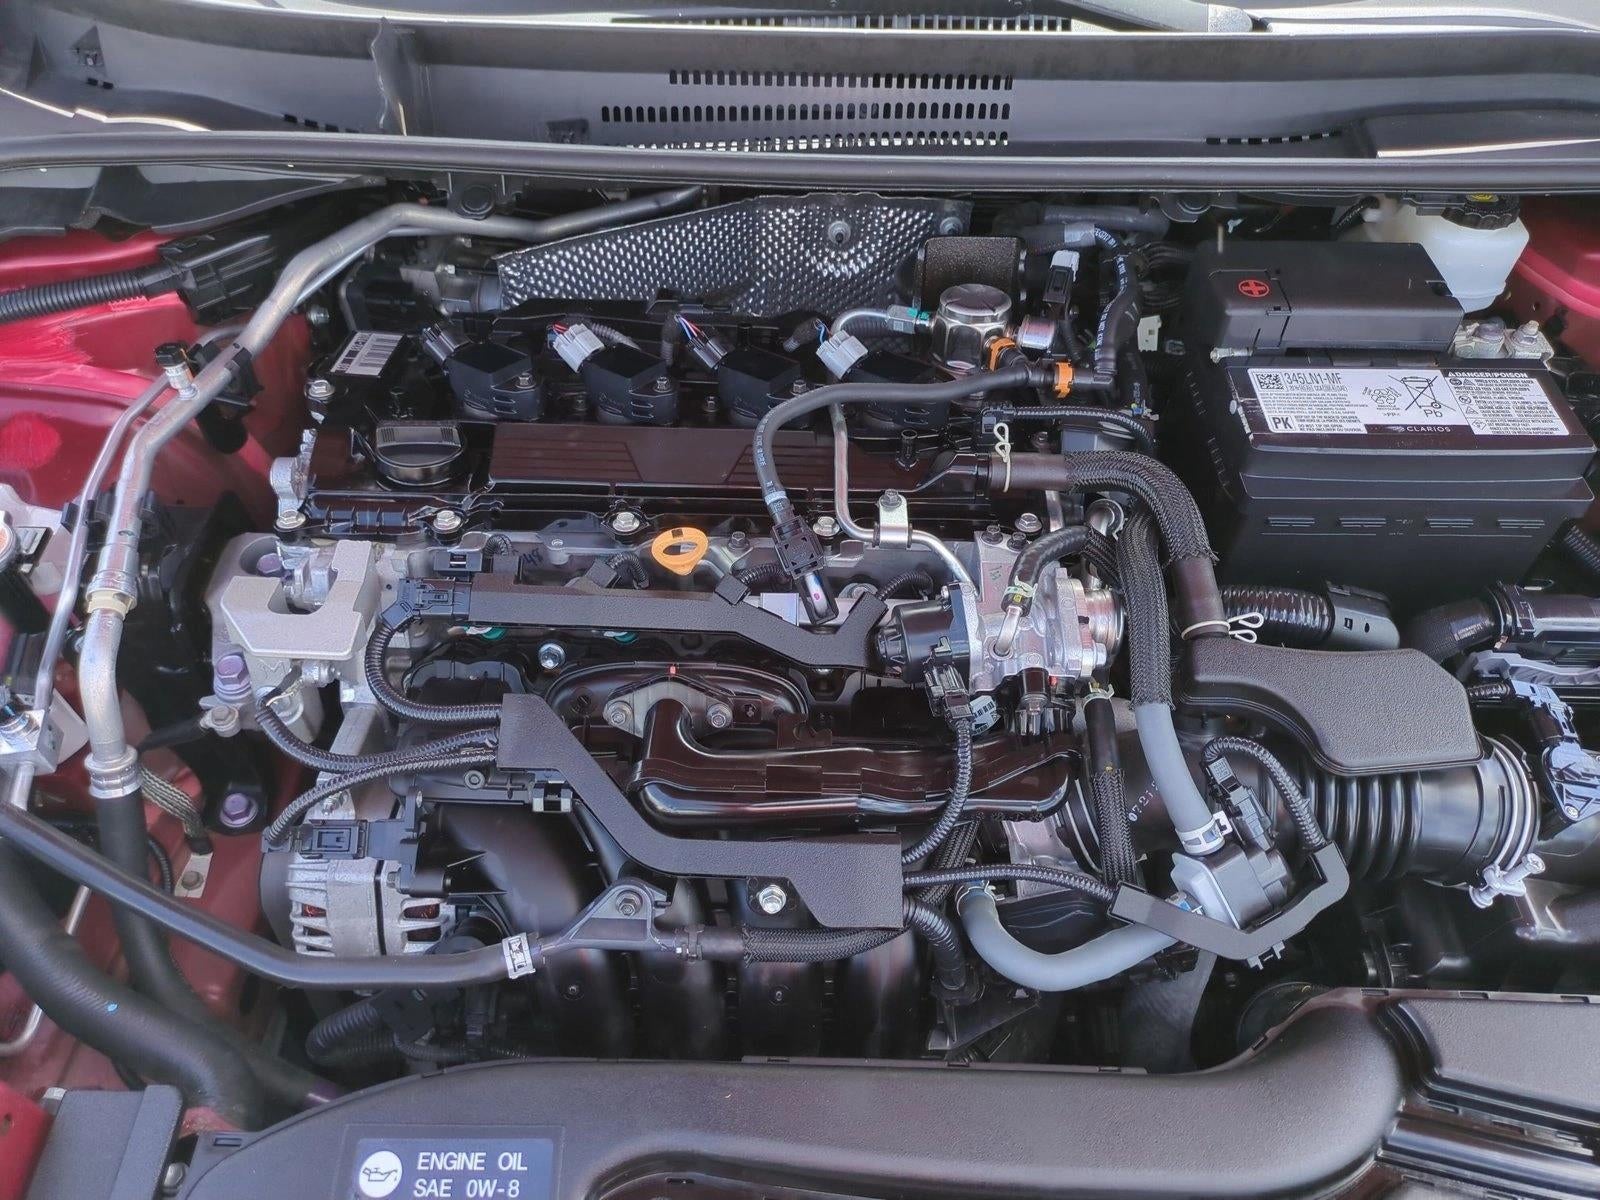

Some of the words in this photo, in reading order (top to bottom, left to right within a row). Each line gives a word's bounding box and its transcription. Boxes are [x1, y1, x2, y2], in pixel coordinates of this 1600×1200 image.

[1284, 372, 1342, 385] 345LN1-MF
[1423, 408, 1443, 418] Pb
[1272, 416, 1293, 430] PK
[1406, 425, 1451, 433] CLARIOS
[416, 1151, 487, 1171] ENGINE
[497, 1151, 528, 1171] OIL
[413, 1178, 453, 1198] SAE
[466, 1179, 520, 1198] 0W-8
